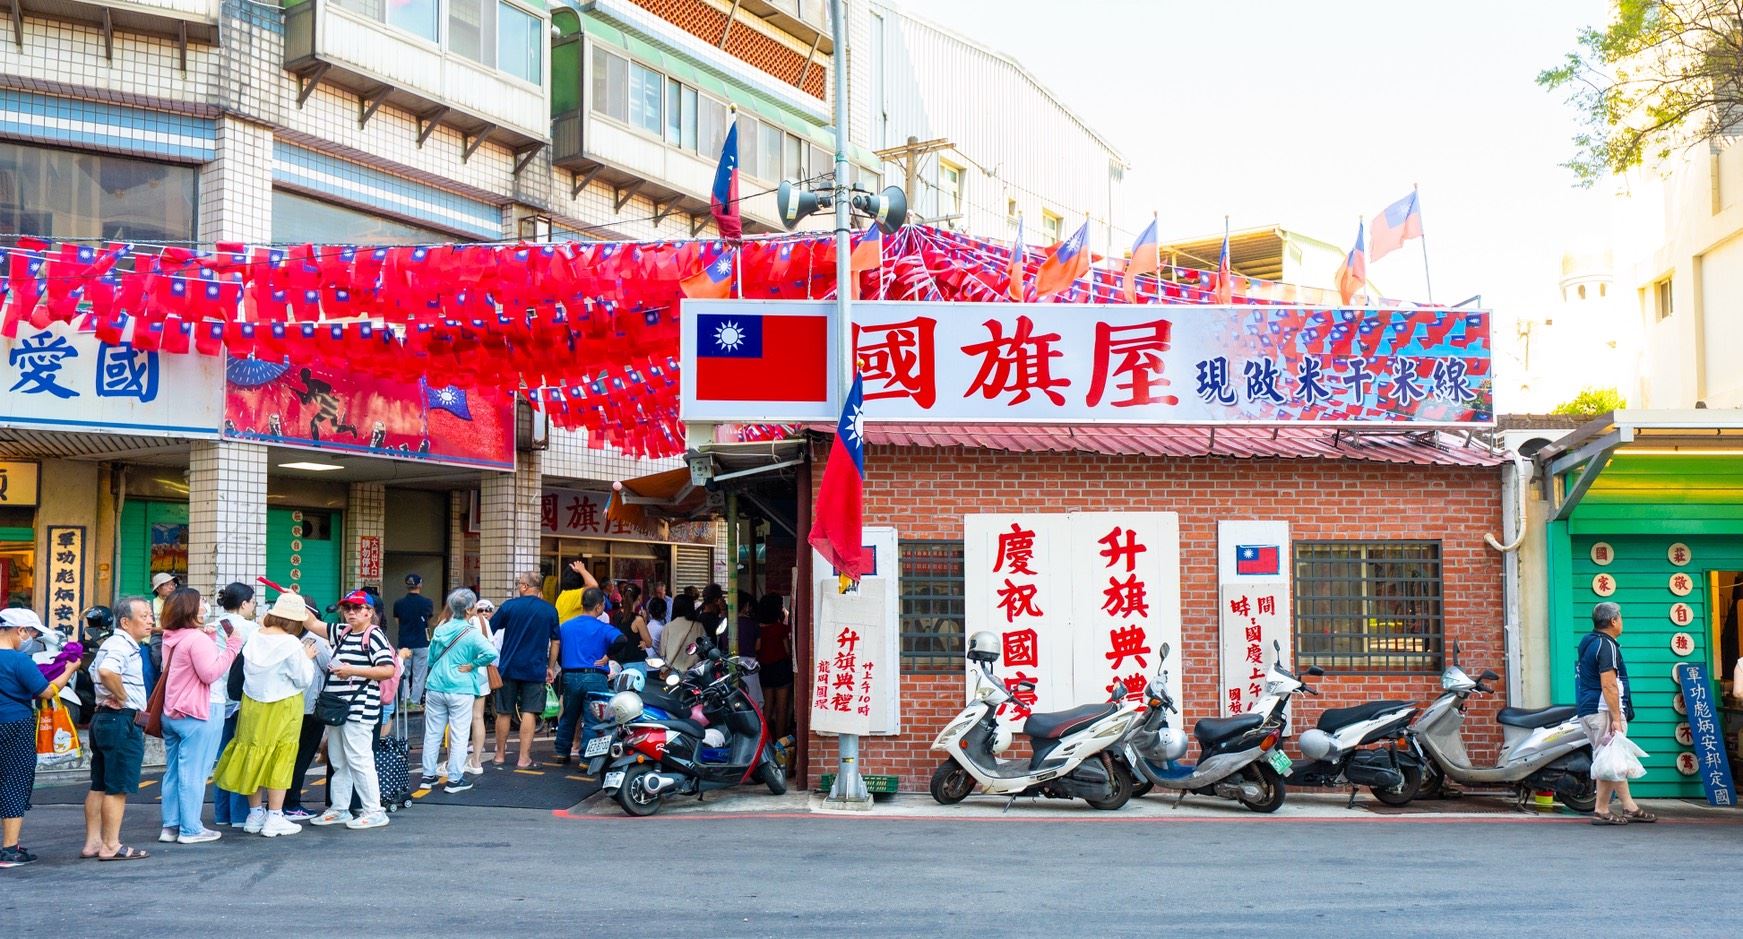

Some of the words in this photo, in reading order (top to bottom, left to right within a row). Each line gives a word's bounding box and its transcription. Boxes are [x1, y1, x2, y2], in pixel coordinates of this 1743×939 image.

[9, 331, 159, 403] 愛國
[851, 315, 1179, 410] 國旗屋
[1195, 356, 1475, 404] 現做米干米線
[993, 523, 1043, 722] 慶祝國慶
[1098, 526, 1150, 713] 升旗典禮
[830, 627, 860, 712] 升旗典禮
[1228, 687, 1242, 716] 國旗
[1686, 667, 1730, 805] 軍功彪炳安邦定國
